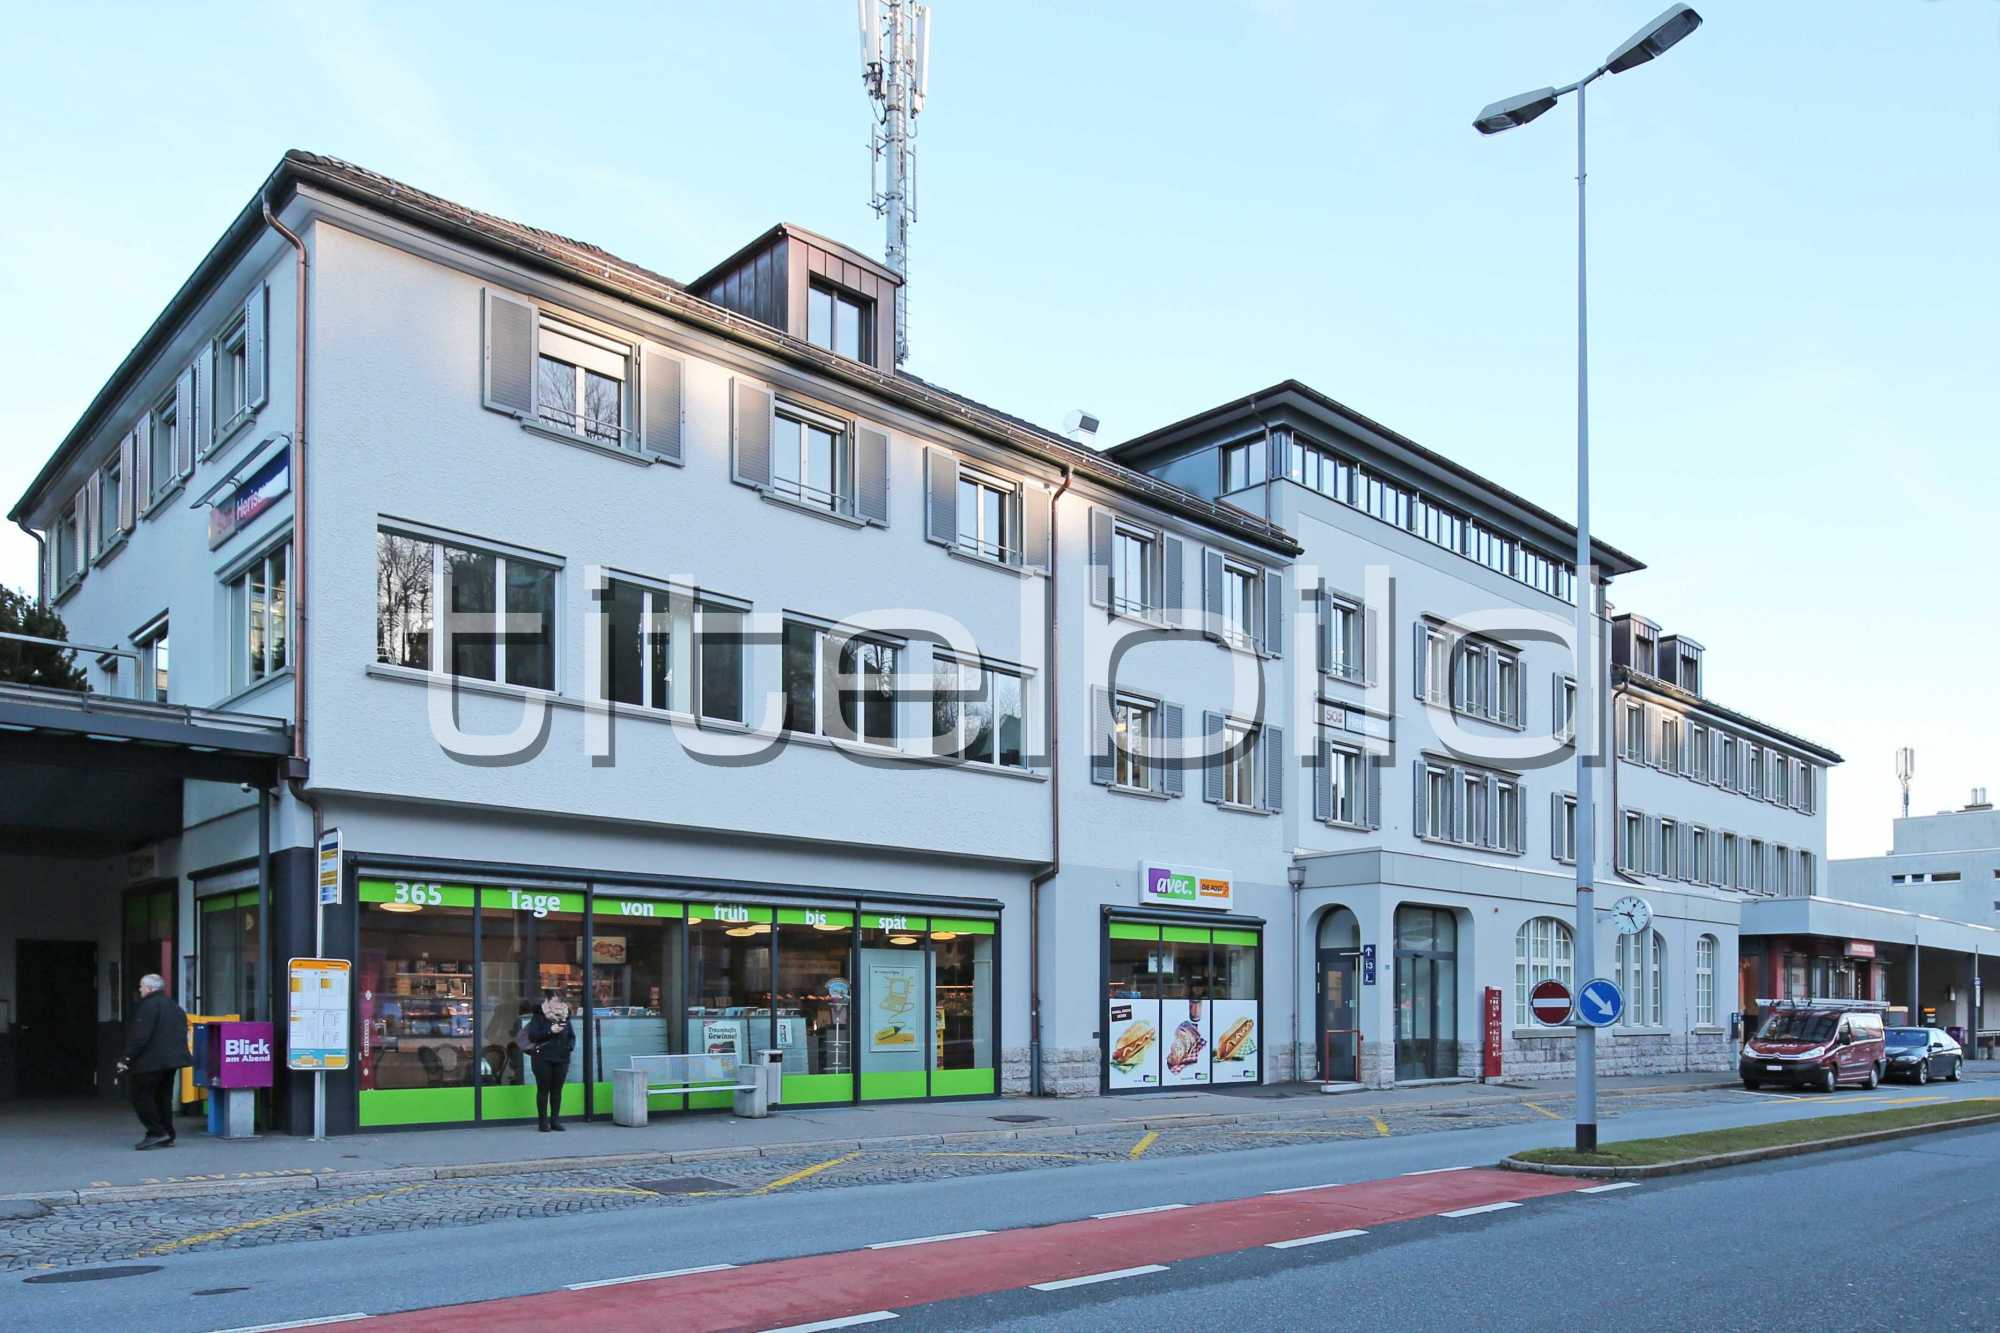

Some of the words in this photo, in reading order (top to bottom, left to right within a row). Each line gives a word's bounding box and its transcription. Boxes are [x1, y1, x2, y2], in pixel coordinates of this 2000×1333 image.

[394, 882, 443, 906] 365
[507, 888, 560, 918] Tage
[621, 901, 655, 917] von
[714, 904, 748, 922] früh
[805, 910, 827, 926] bis
[879, 914, 907, 934] spät
[225, 1038, 270, 1056] Blick
[241, 1054, 271, 1062] Abend
